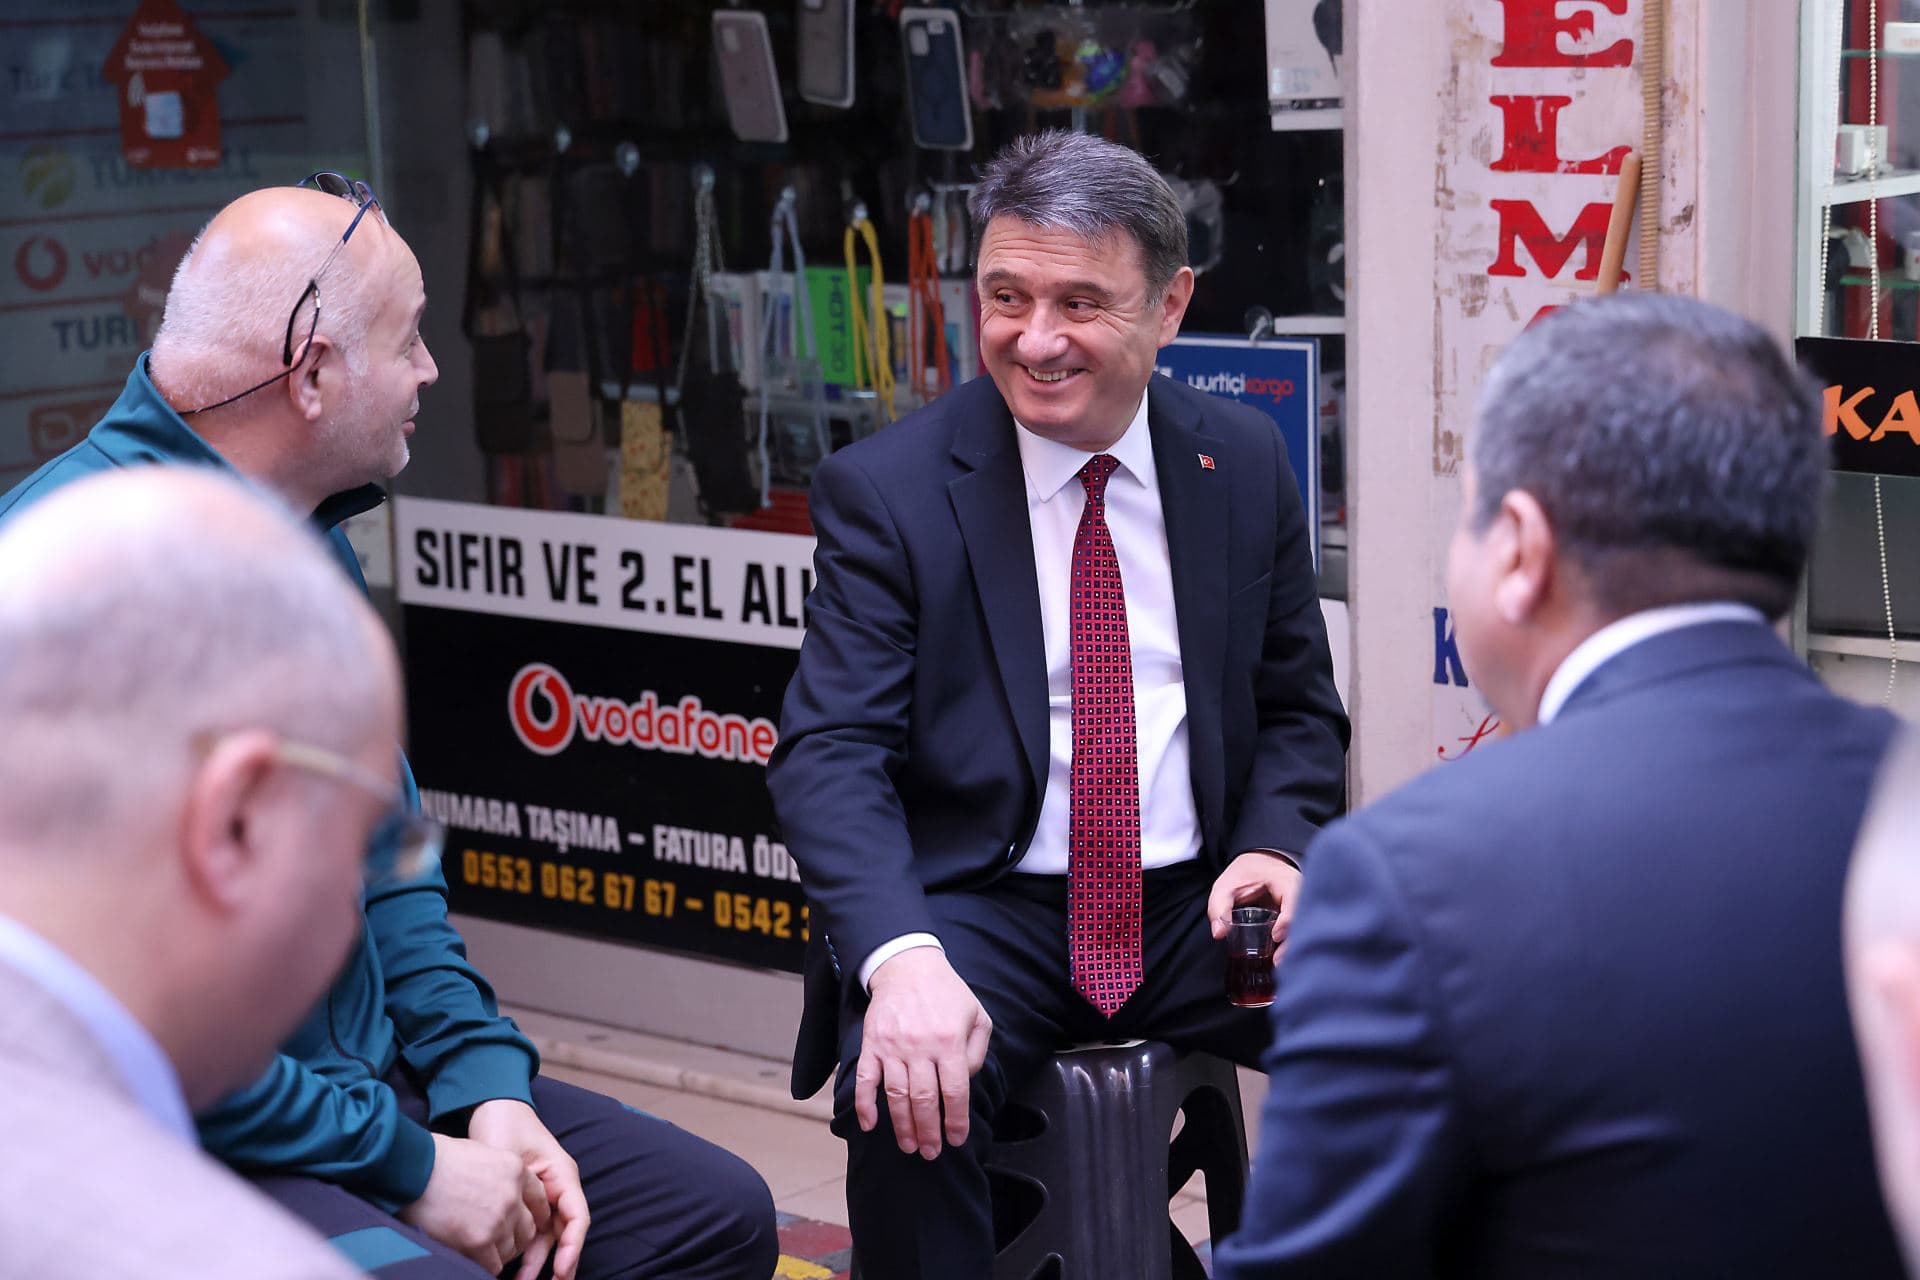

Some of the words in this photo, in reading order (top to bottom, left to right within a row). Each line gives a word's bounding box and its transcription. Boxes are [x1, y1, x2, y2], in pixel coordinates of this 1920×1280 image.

[415, 529, 525, 597] SIFIR
[542, 542, 599, 606] VE
[621, 550, 723, 620] 2.EL
[577, 693, 777, 763] vodafone
[525, 803, 621, 853] TAŞIMA
[652, 824, 747, 873] FATURA
[463, 848, 531, 894] 0553
[541, 862, 595, 904] 062
[604, 873, 634, 912] 67
[644, 880, 677, 919] 67
[714, 890, 792, 939] 0542
